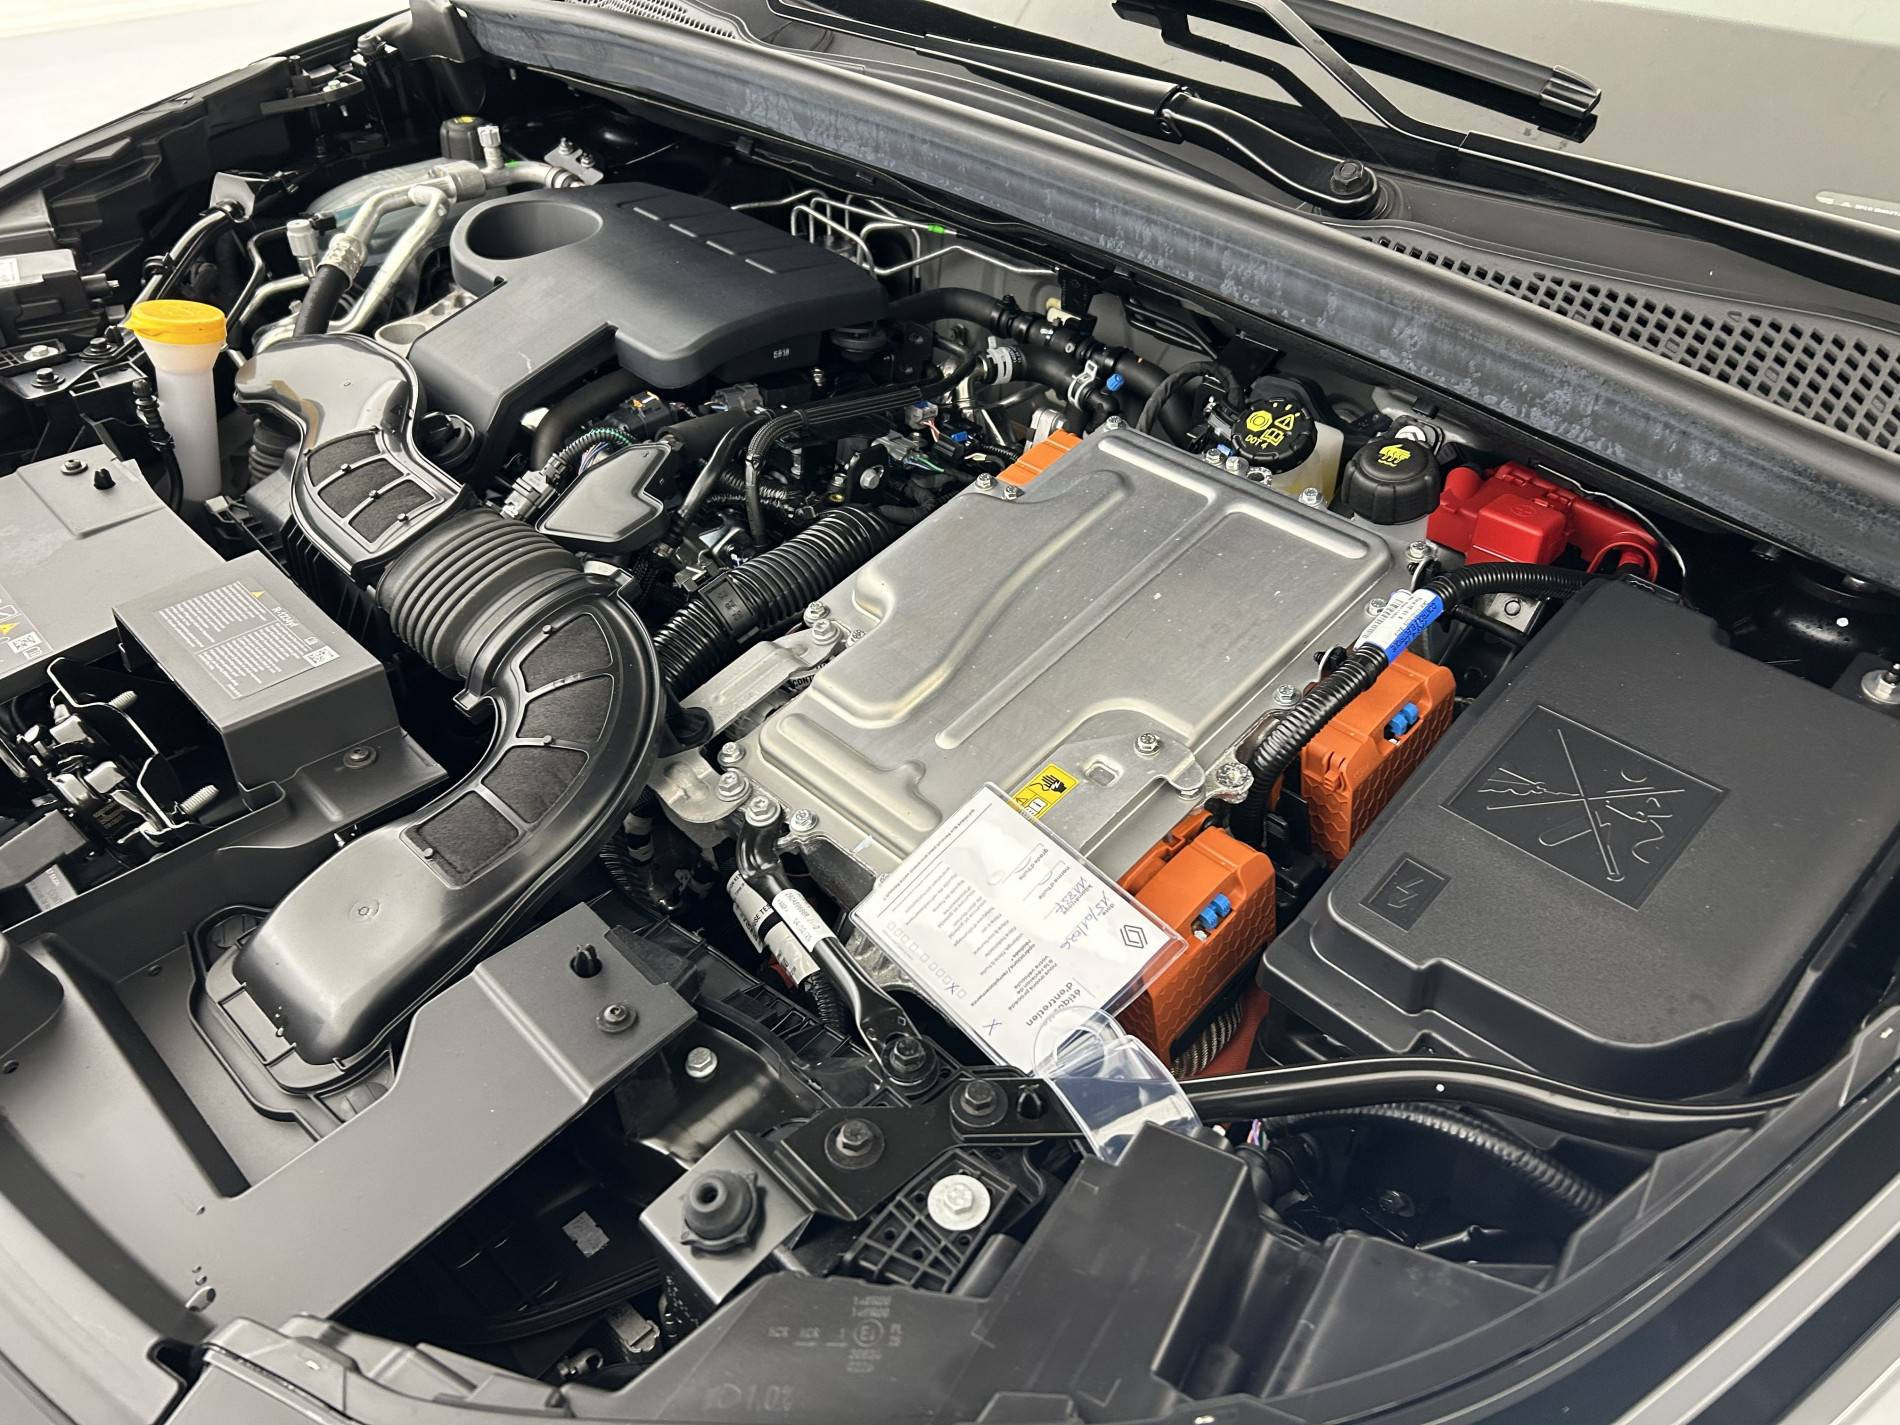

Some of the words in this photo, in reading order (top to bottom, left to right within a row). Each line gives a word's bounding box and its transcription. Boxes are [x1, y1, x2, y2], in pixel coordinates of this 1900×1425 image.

[1244, 434, 1262, 446] DOT
[791, 672, 817, 687] CONT
[1100, 902, 1115, 916] date
[1024, 981, 1075, 1027] d'entretien
